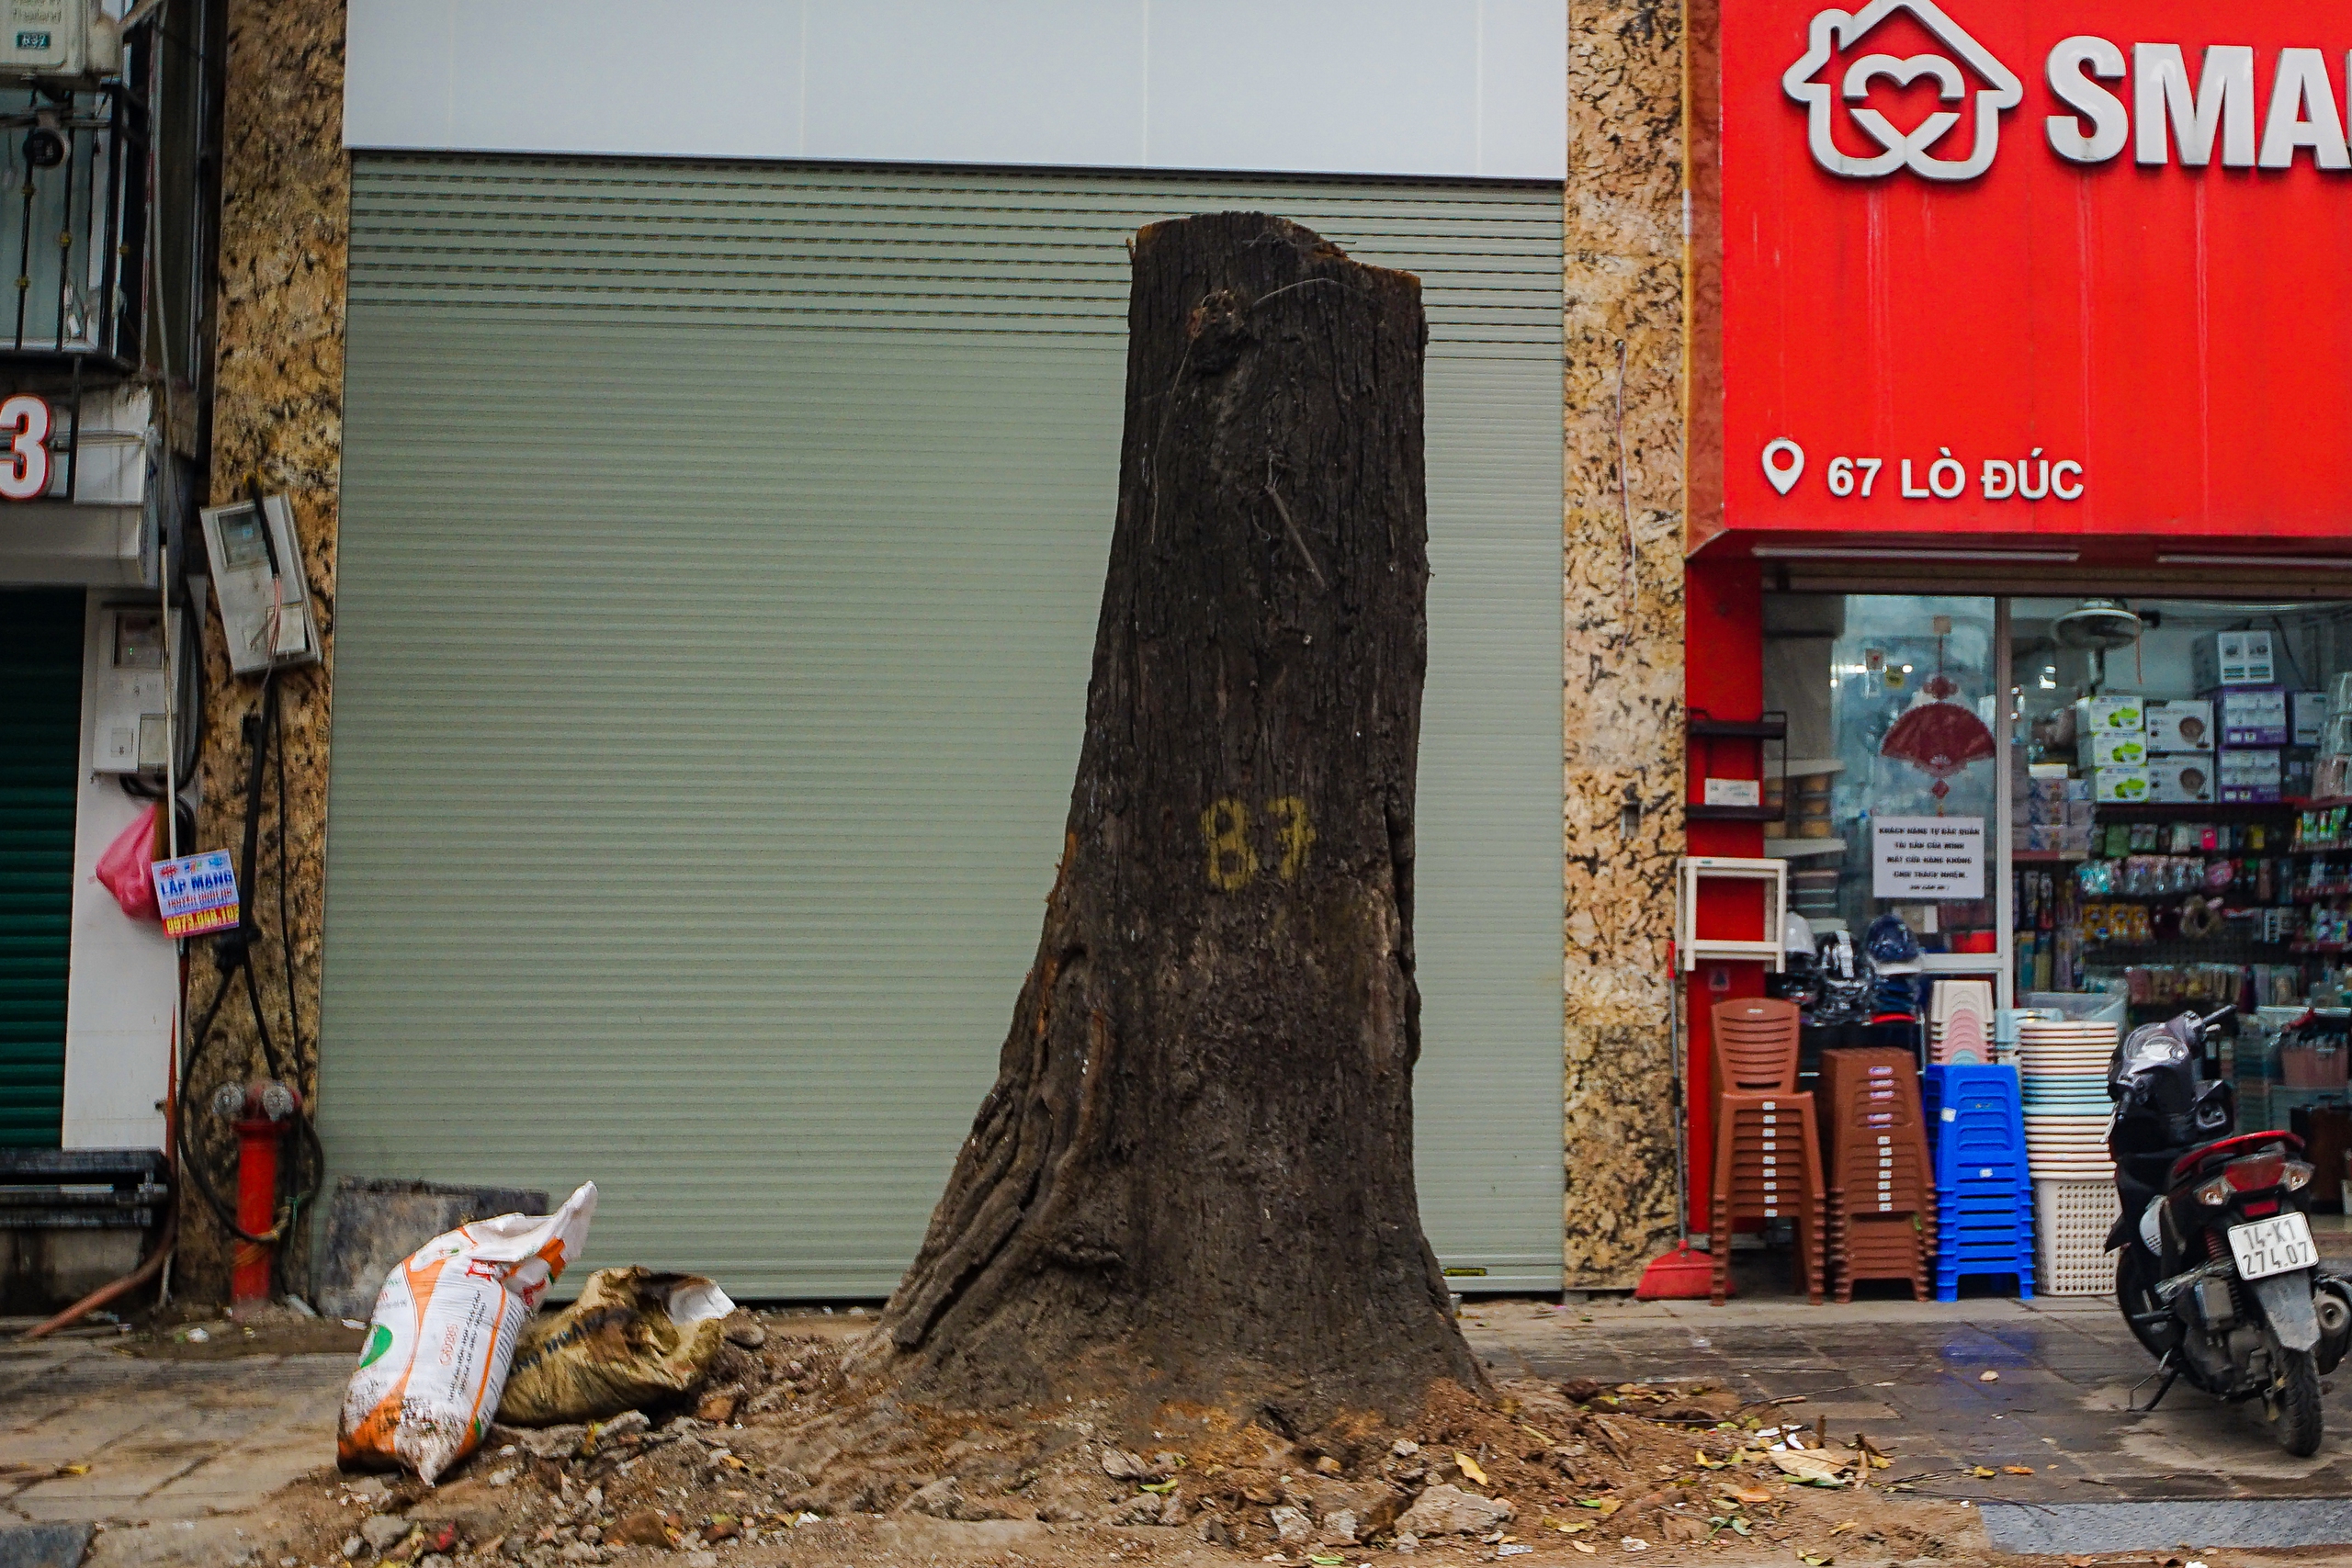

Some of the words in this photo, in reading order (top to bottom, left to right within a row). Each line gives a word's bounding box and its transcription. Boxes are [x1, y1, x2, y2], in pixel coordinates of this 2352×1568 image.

[2045, 35, 2352, 169] SMA
[1827, 457, 1883, 498] 67
[1901, 447, 1966, 499] LÒ
[1981, 447, 2085, 500] ĐÚC
[2243, 1219, 2296, 1250] 14-K1
[2243, 1241, 2308, 1276] 274.07
